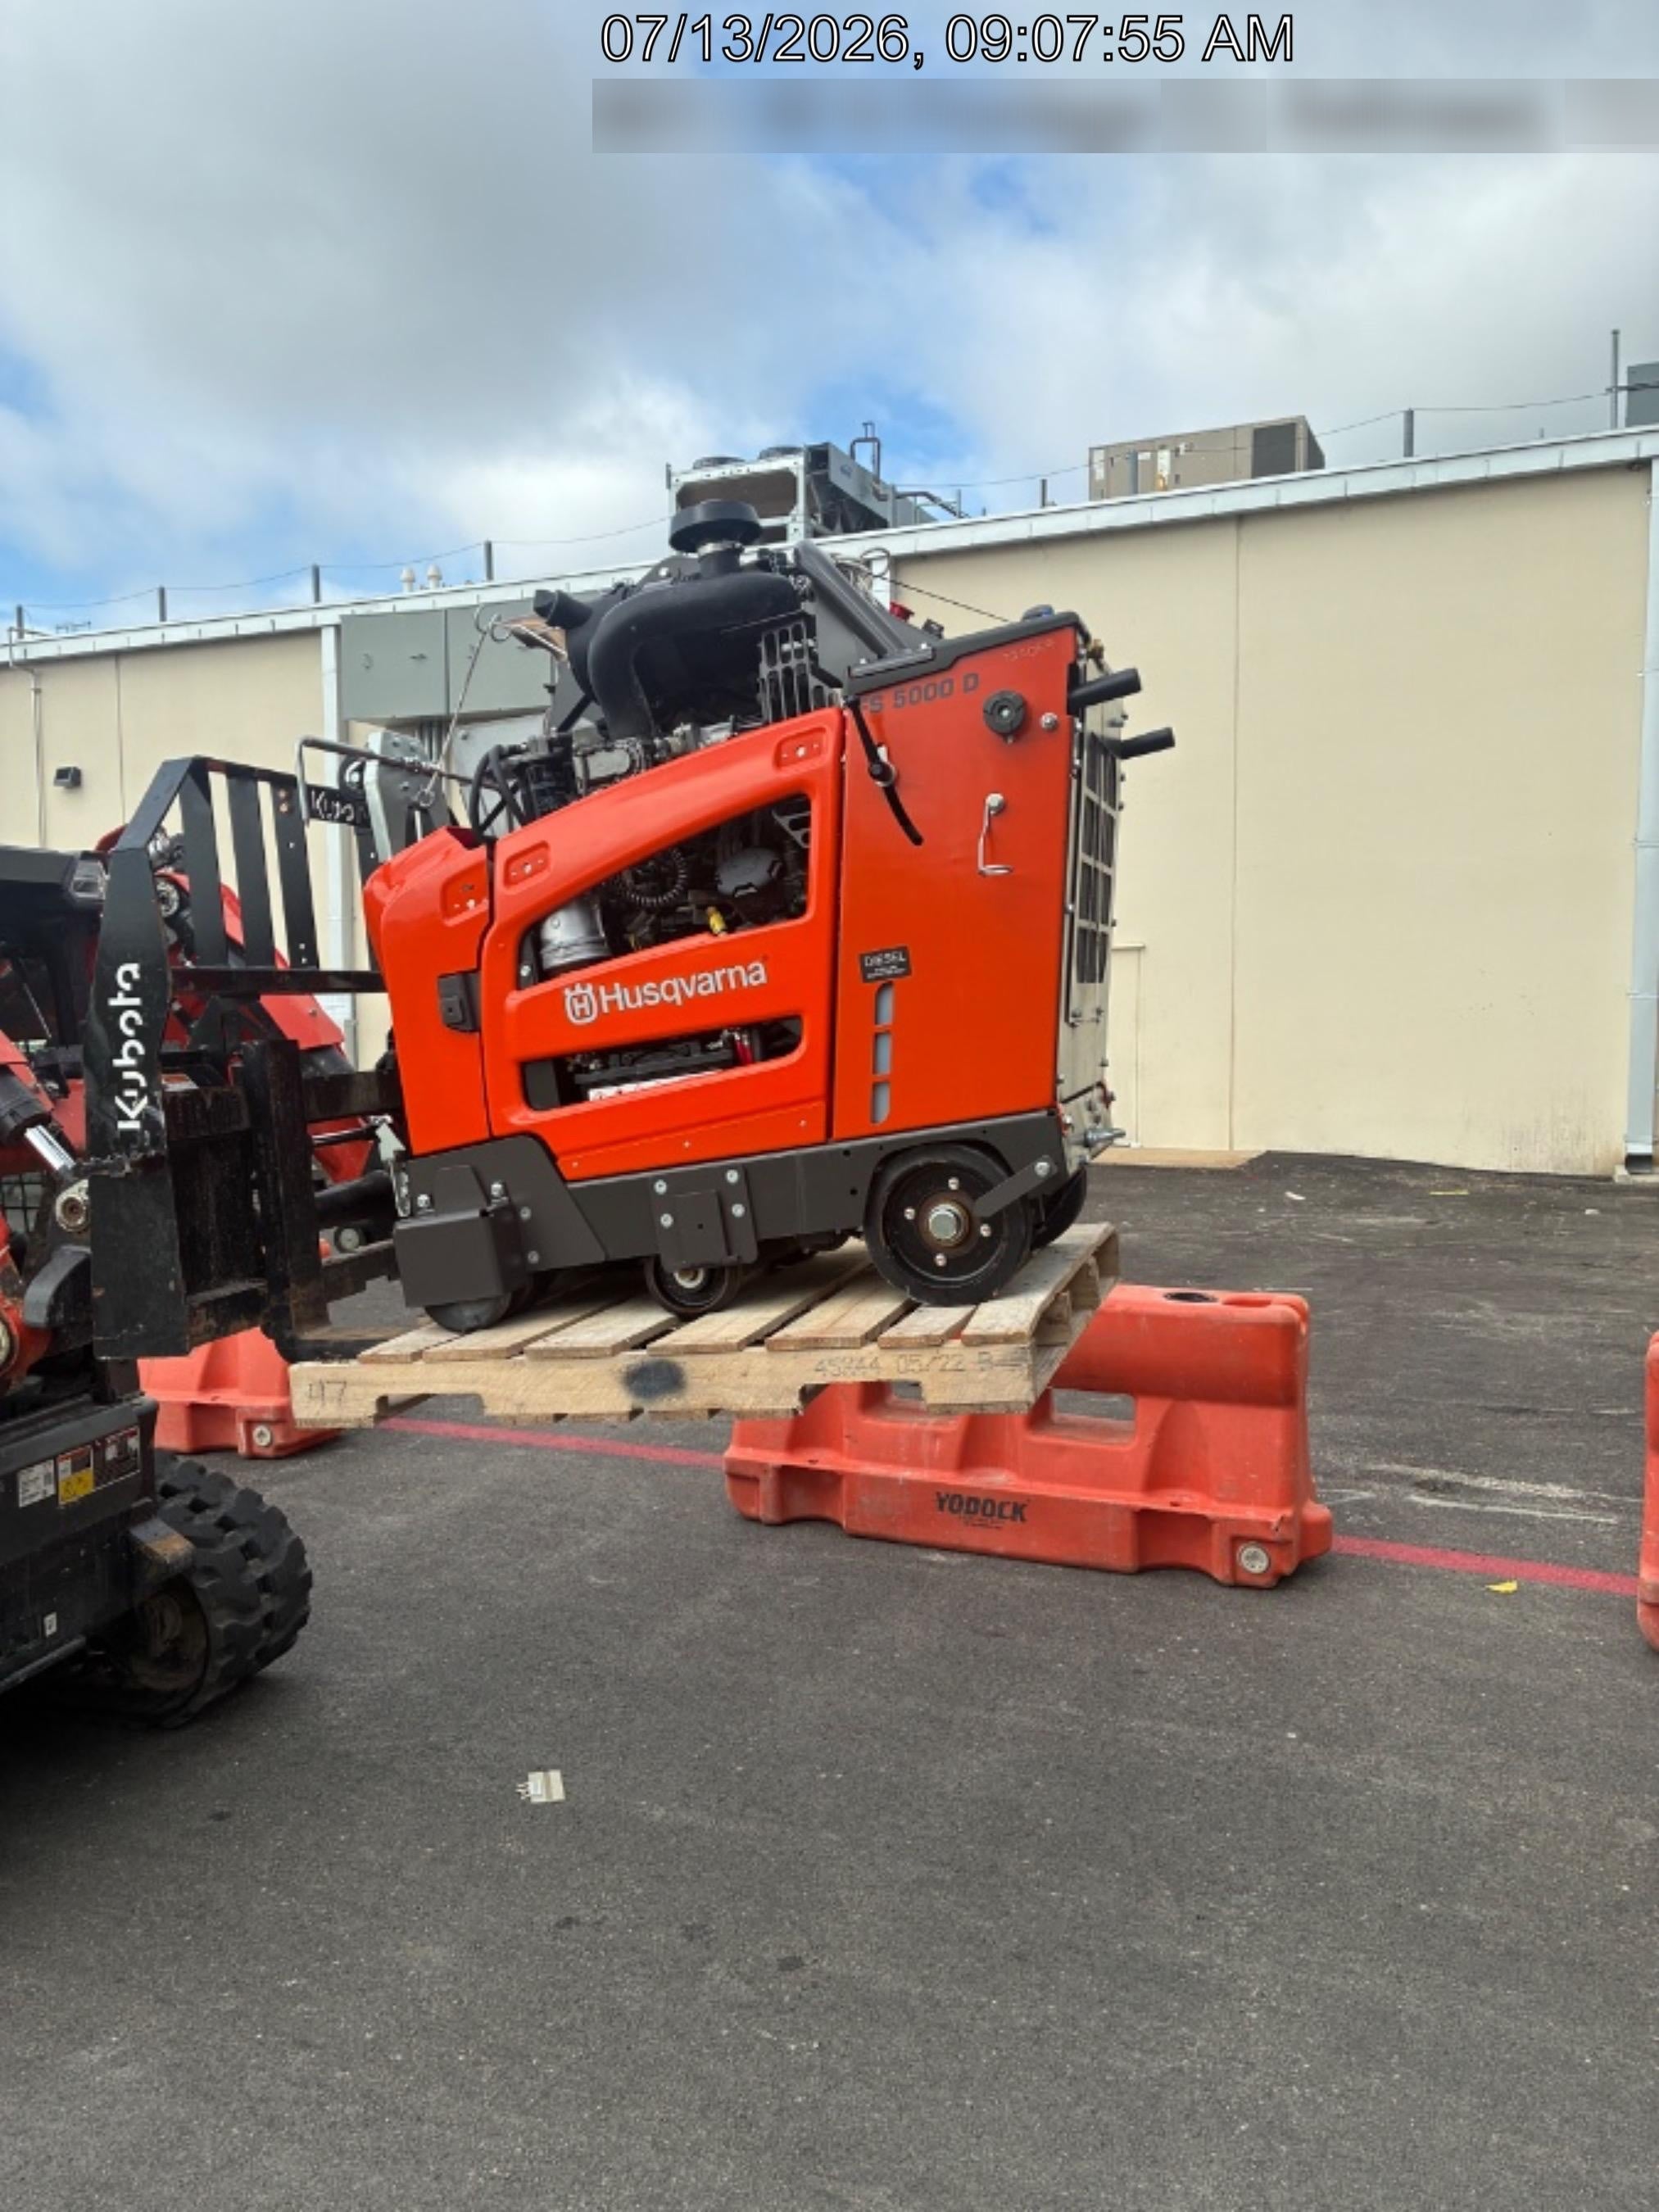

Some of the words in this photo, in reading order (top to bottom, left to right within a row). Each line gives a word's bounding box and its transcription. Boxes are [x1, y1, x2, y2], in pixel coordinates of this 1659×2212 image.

[894, 678, 954, 709] 5000
[963, 673, 979, 691] D
[599, 960, 768, 1014] Husqvarna
[107, 963, 148, 1130] Kubota
[935, 1491, 1031, 1523] YODOCK
